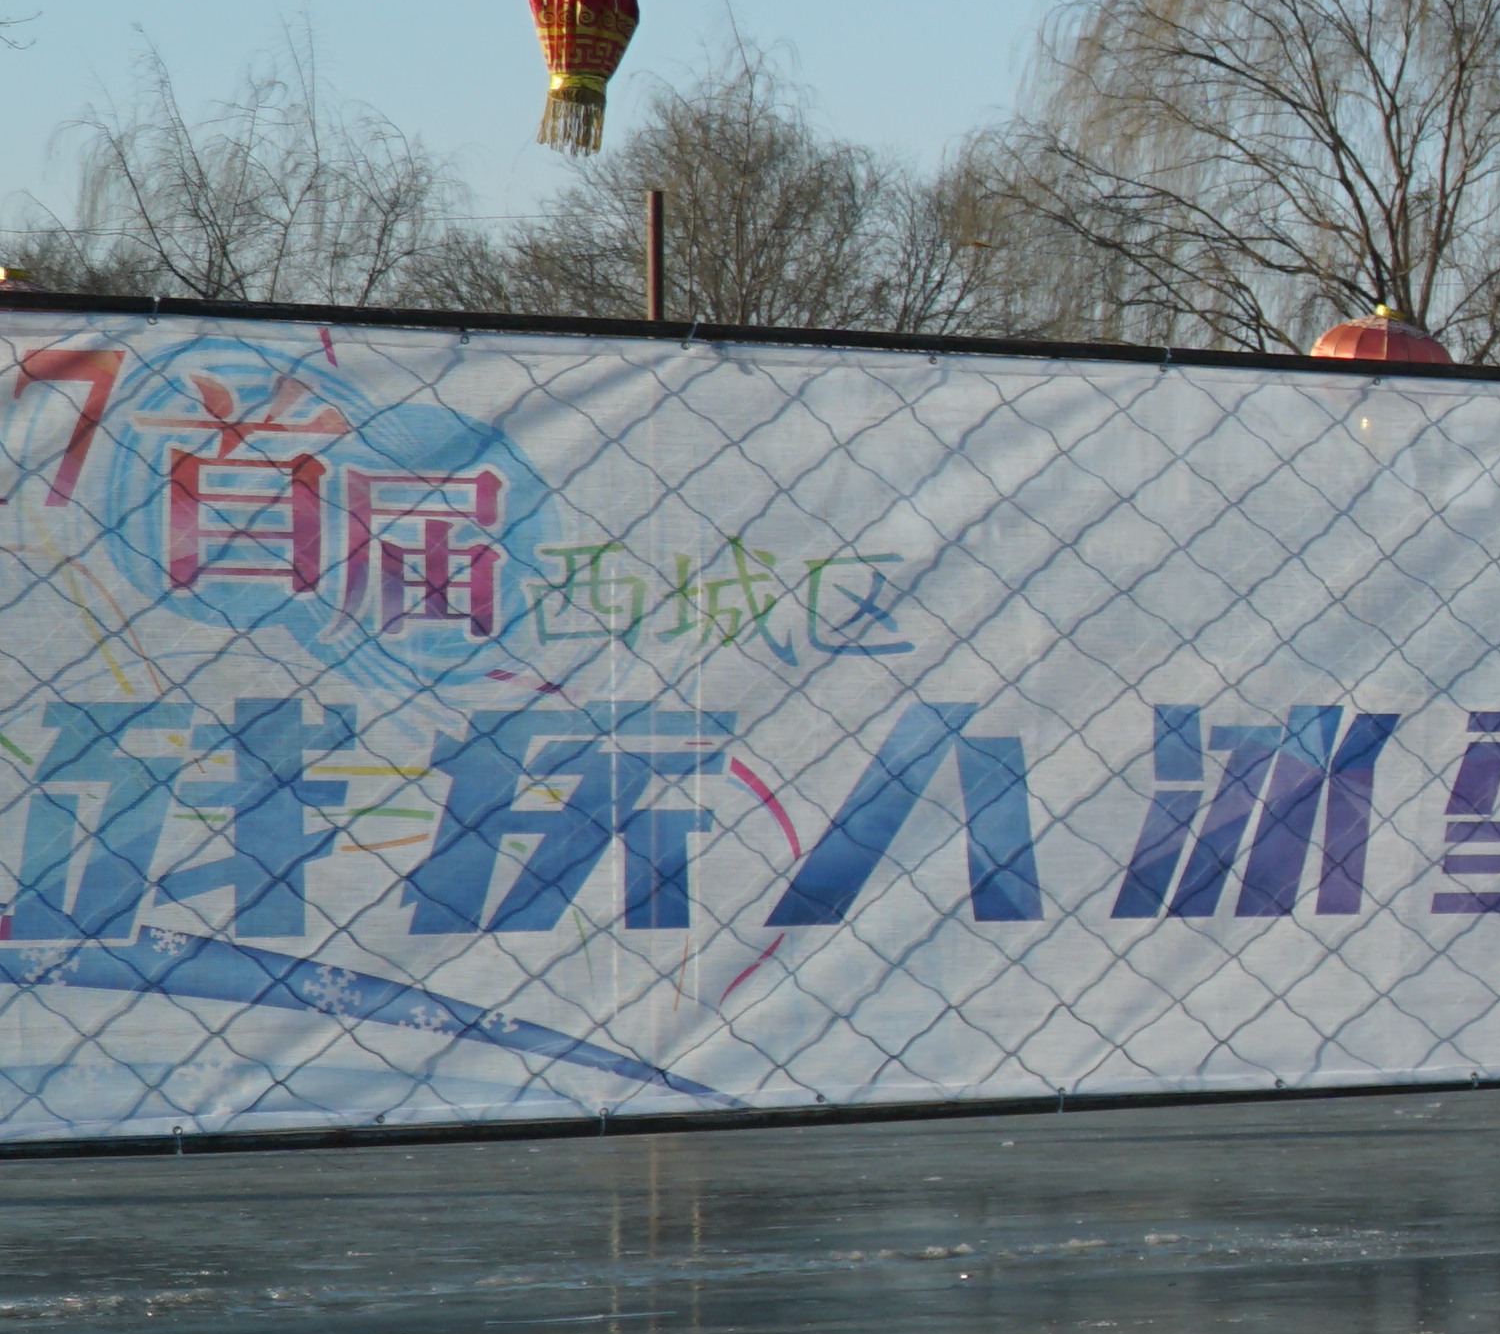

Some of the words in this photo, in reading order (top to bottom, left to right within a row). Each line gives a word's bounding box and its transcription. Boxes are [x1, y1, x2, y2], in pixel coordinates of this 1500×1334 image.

[132, 373, 502, 638] 首届
[528, 535, 916, 667] 西城区
